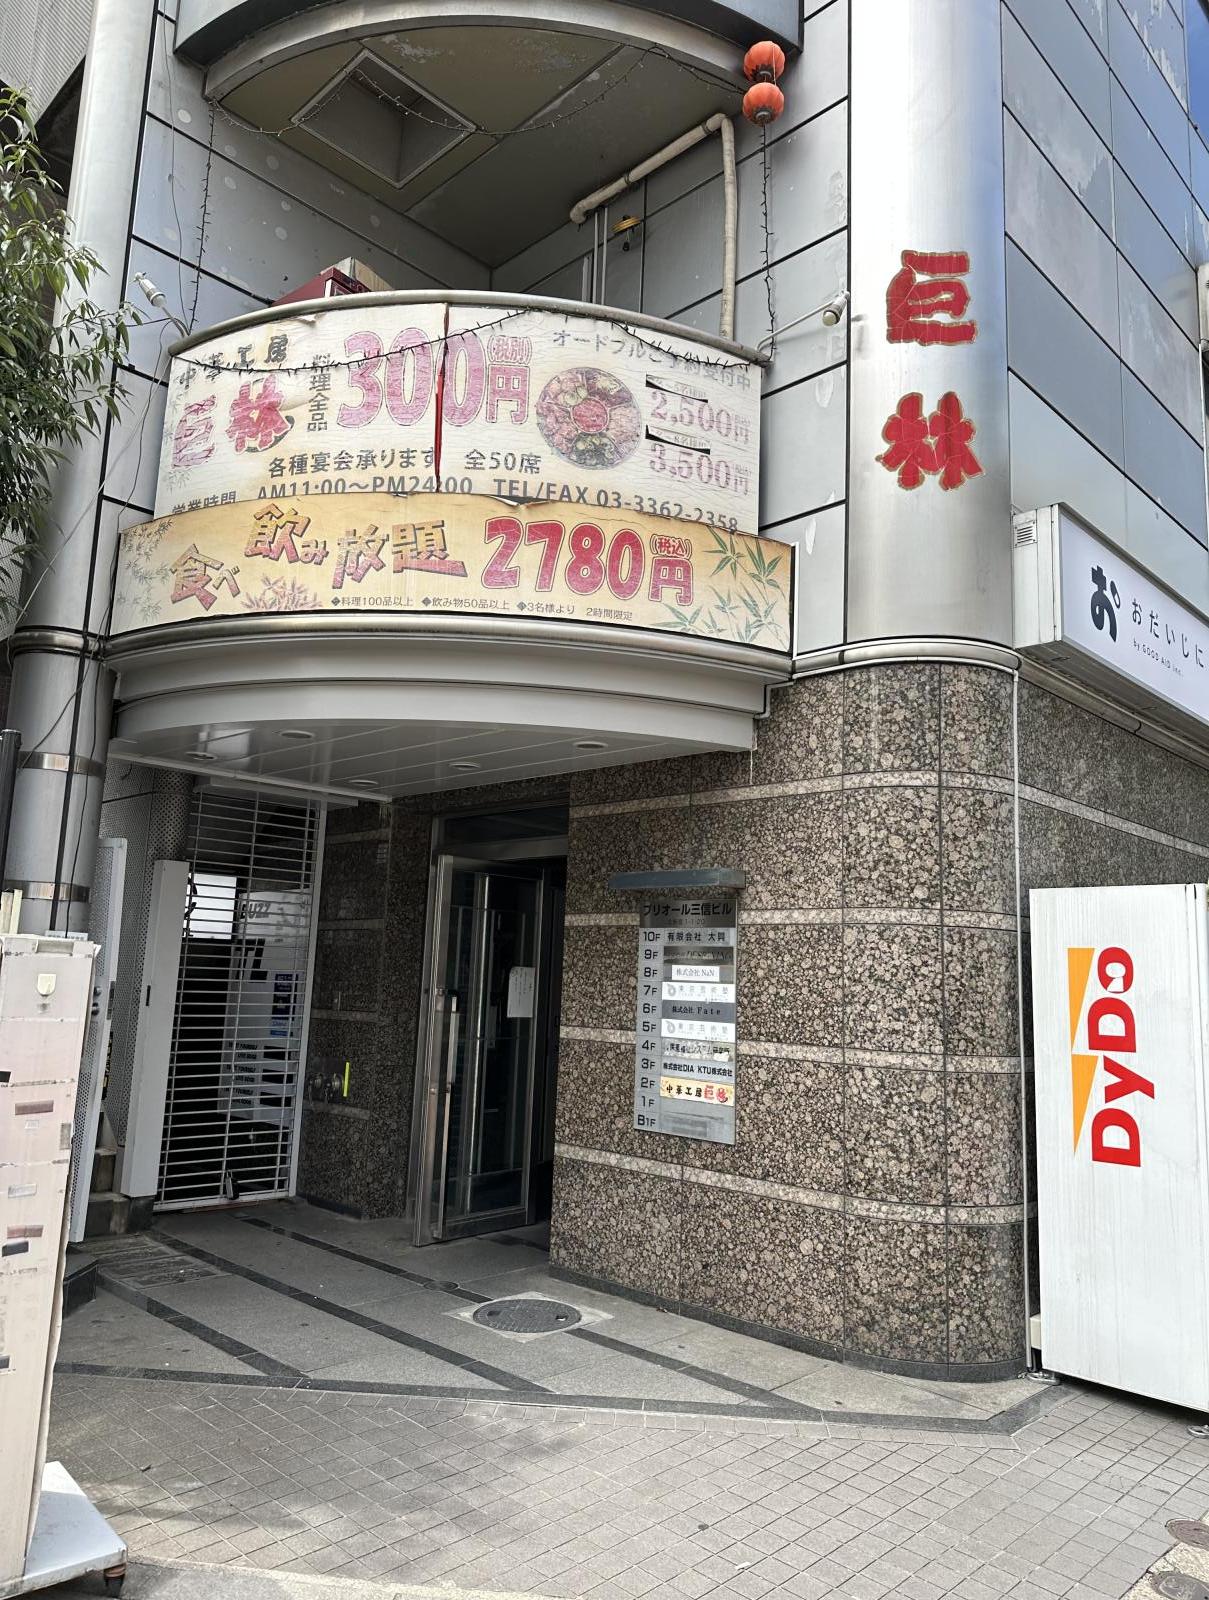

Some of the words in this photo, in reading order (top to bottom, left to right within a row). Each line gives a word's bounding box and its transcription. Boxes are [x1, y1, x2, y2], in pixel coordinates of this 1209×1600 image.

[268, 448, 435, 479] 各種宴会承ります
[464, 449, 542, 474] 全50席
[494, 478, 589, 507] TEL/FAX
[596, 489, 738, 535] 03-3362-2358
[480, 515, 694, 607] 2780円
[341, 596, 413, 608] 料理100品以上
[431, 597, 510, 611] 飲み物50品以上
[526, 601, 576, 615] 3名様より
[586, 607, 633, 621] 2時間限定
[1131, 598, 1204, 669] おだいじに
[643, 931, 661, 942] 10F
[644, 949, 659, 960] 9F
[643, 967, 658, 978] 8F
[643, 984, 658, 996] 7F
[642, 1003, 657, 1014] 6F
[642, 1021, 657, 1032] 5F
[641, 1040, 656, 1051] 4F
[1087, 946, 1155, 1168] DyDo
[641, 1058, 656, 1069] 3F
[640, 1077, 655, 1088] 2F
[641, 1095, 655, 1107] 1F
[637, 1114, 656, 1126] B1F
